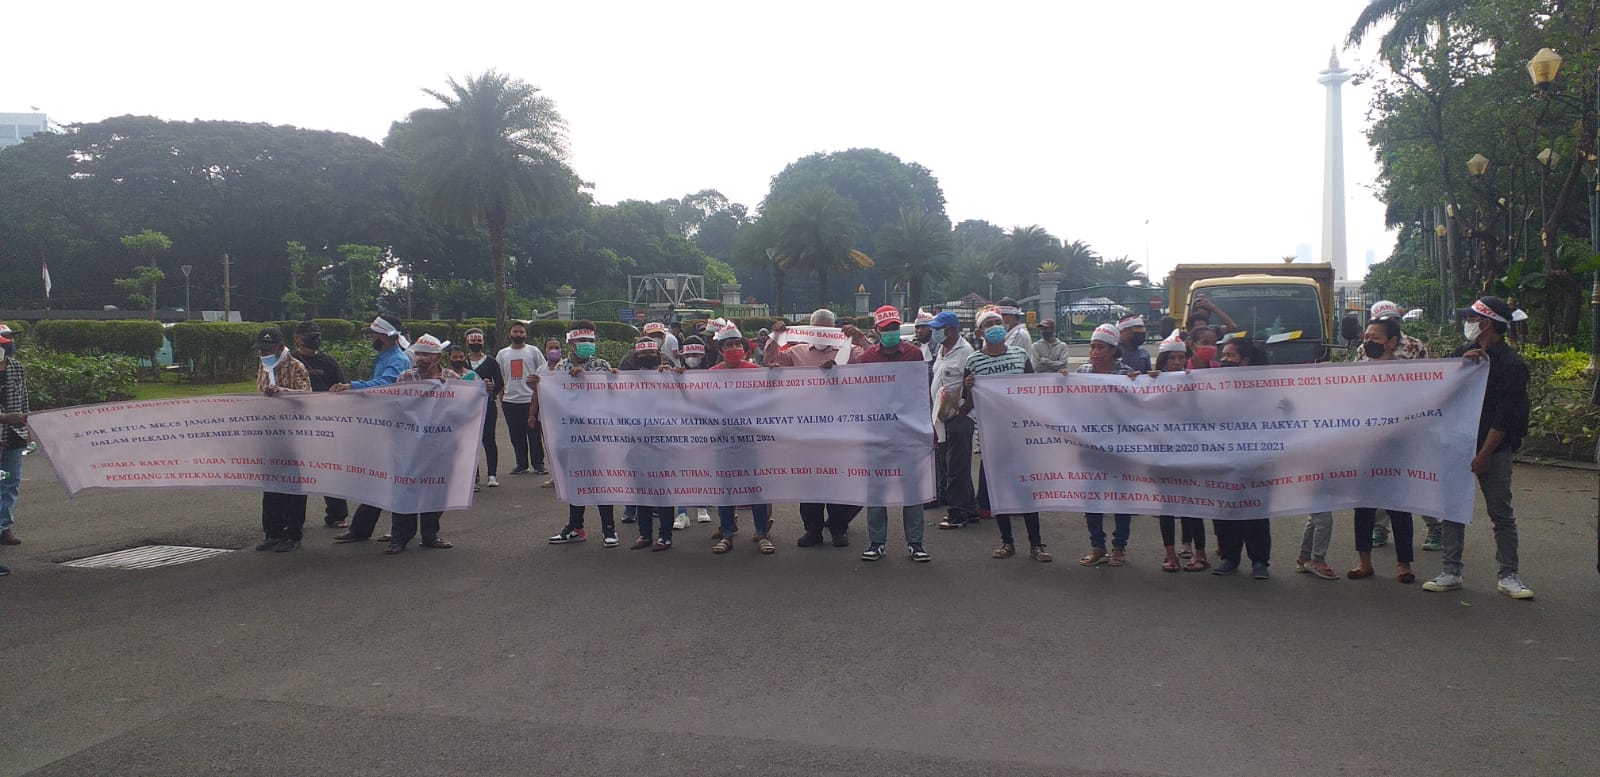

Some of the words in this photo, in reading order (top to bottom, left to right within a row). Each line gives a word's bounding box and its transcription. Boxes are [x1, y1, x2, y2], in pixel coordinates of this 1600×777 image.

[786, 328, 815, 337] YALIMO
[562, 382, 569, 390] 1.
[570, 382, 584, 390] PSU
[586, 382, 606, 392] JILID
[607, 381, 655, 390] KABUPATEN
[724, 381, 733, 389] 17
[736, 379, 784, 389] DESEMBER
[786, 379, 805, 387] 2021
[807, 377, 839, 386] SUDAH
[841, 374, 896, 385] ALMARHUM
[1006, 386, 1014, 394] 1.
[1017, 386, 1036, 395] PSU
[1038, 385, 1064, 396] JILID
[1066, 384, 1129, 394] KABUPATEN
[1132, 383, 1217, 395] YALIMO-PAPUA,
[1220, 380, 1230, 390] 17
[1234, 378, 1295, 389] DESEMBER
[1298, 376, 1322, 386] 2021
[1325, 375, 1366, 385] SUDAH
[1369, 371, 1444, 383] ALMARHUM
[74, 408, 93, 417] PSU
[97, 406, 124, 415] JILID
[127, 399, 190, 409] KABUPATEN
[85, 428, 108, 436] PAK
[110, 424, 146, 433] KETUA
[185, 417, 225, 427] JANGAN
[229, 414, 275, 423] MATIKAN
[315, 415, 353, 423] RAKYAT
[356, 416, 392, 427] YALIMO
[422, 424, 452, 434] SUARA
[569, 417, 585, 425] PAK
[587, 417, 614, 426] KETUA
[643, 418, 677, 428] JANGAN
[680, 417, 719, 426] MATIKAN
[722, 416, 753, 426] SUARA
[756, 416, 794, 425] RAKYAT
[797, 415, 834, 424] YALIMO
[837, 414, 864, 423] 47.781
[867, 412, 899, 422] SUARA
[1011, 421, 1019, 429] 2.
[1117, 423, 1160, 435] JANGAN
[1163, 422, 1216, 432] MATIKAN
[1219, 421, 1258, 431] SUARA
[1262, 419, 1309, 430] RAKYAT
[1313, 418, 1360, 429] YALIMO
[1364, 416, 1399, 427] 47.781
[91, 438, 129, 447] DALAM
[131, 434, 176, 443] PILKADA
[187, 430, 240, 439] DESEMBER
[315, 430, 335, 438] 2021
[571, 434, 601, 443] DALAM
[602, 434, 636, 444] PILKADA
[637, 435, 642, 444] 9
[644, 434, 689, 444] DESEMBER
[690, 434, 707, 444] 2020
[710, 435, 729, 443] DAN
[730, 435, 736, 443] 5
[736, 434, 754, 443] MEI
[756, 433, 776, 442] 2021
[1025, 437, 1062, 446] DALAM
[1107, 445, 1113, 453] 9
[1116, 444, 1174, 453] DESEMBER
[1175, 443, 1198, 453] 2020
[1202, 443, 1226, 452] DAN
[1228, 443, 1234, 451] 5
[1237, 442, 1259, 451] MEI
[1261, 441, 1284, 451] 2021
[100, 461, 135, 469] SUARA
[139, 459, 179, 467] RAKYAT
[193, 457, 226, 465] SUARA
[269, 458, 306, 467] SEGERA
[309, 460, 342, 471] LANTIK
[346, 464, 366, 475] ERDI
[369, 468, 387, 480] DABI
[394, 474, 416, 485] JOHN
[419, 476, 446, 485] WILIL
[106, 472, 162, 481] PEMEGANG
[178, 472, 221, 480] PILKADA
[223, 472, 279, 482] KABUPATEN
[280, 474, 317, 485] YALIMO
[574, 469, 603, 478] SUARA
[606, 469, 637, 478] RAKYAT
[647, 470, 676, 478] SUARA
[715, 469, 749, 478] SEGERA
[753, 468, 787, 477] LANTIK
[791, 467, 812, 475] ERDI
[816, 467, 838, 475] DABI
[847, 468, 871, 478] JOHN
[874, 468, 904, 477] WILIL
[1019, 474, 1028, 483] 3.
[1030, 472, 1064, 482] SUARA
[1068, 471, 1109, 481] RAKYAT
[1121, 473, 1157, 484] SUARA
[1160, 476, 1201, 488] TUHAN,
[1204, 479, 1247, 491] SEGERA
[1251, 476, 1293, 489] LANTIK
[1297, 472, 1325, 483] ERDI
[1329, 469, 1358, 479] DABI
[1370, 467, 1401, 478] JOHN
[1406, 468, 1439, 483] WILIL
[577, 486, 624, 495] PEMEGANG
[636, 487, 672, 496] PILKADA
[674, 487, 725, 496] KABUPATEN
[726, 485, 763, 495] YALIMO
[1032, 490, 1087, 500] PEMEGANG
[1087, 491, 1101, 500] 2X
[1104, 492, 1151, 503] PILKADA
[1152, 494, 1215, 507] KABUPATEN
[1216, 499, 1262, 509] YALIMO
